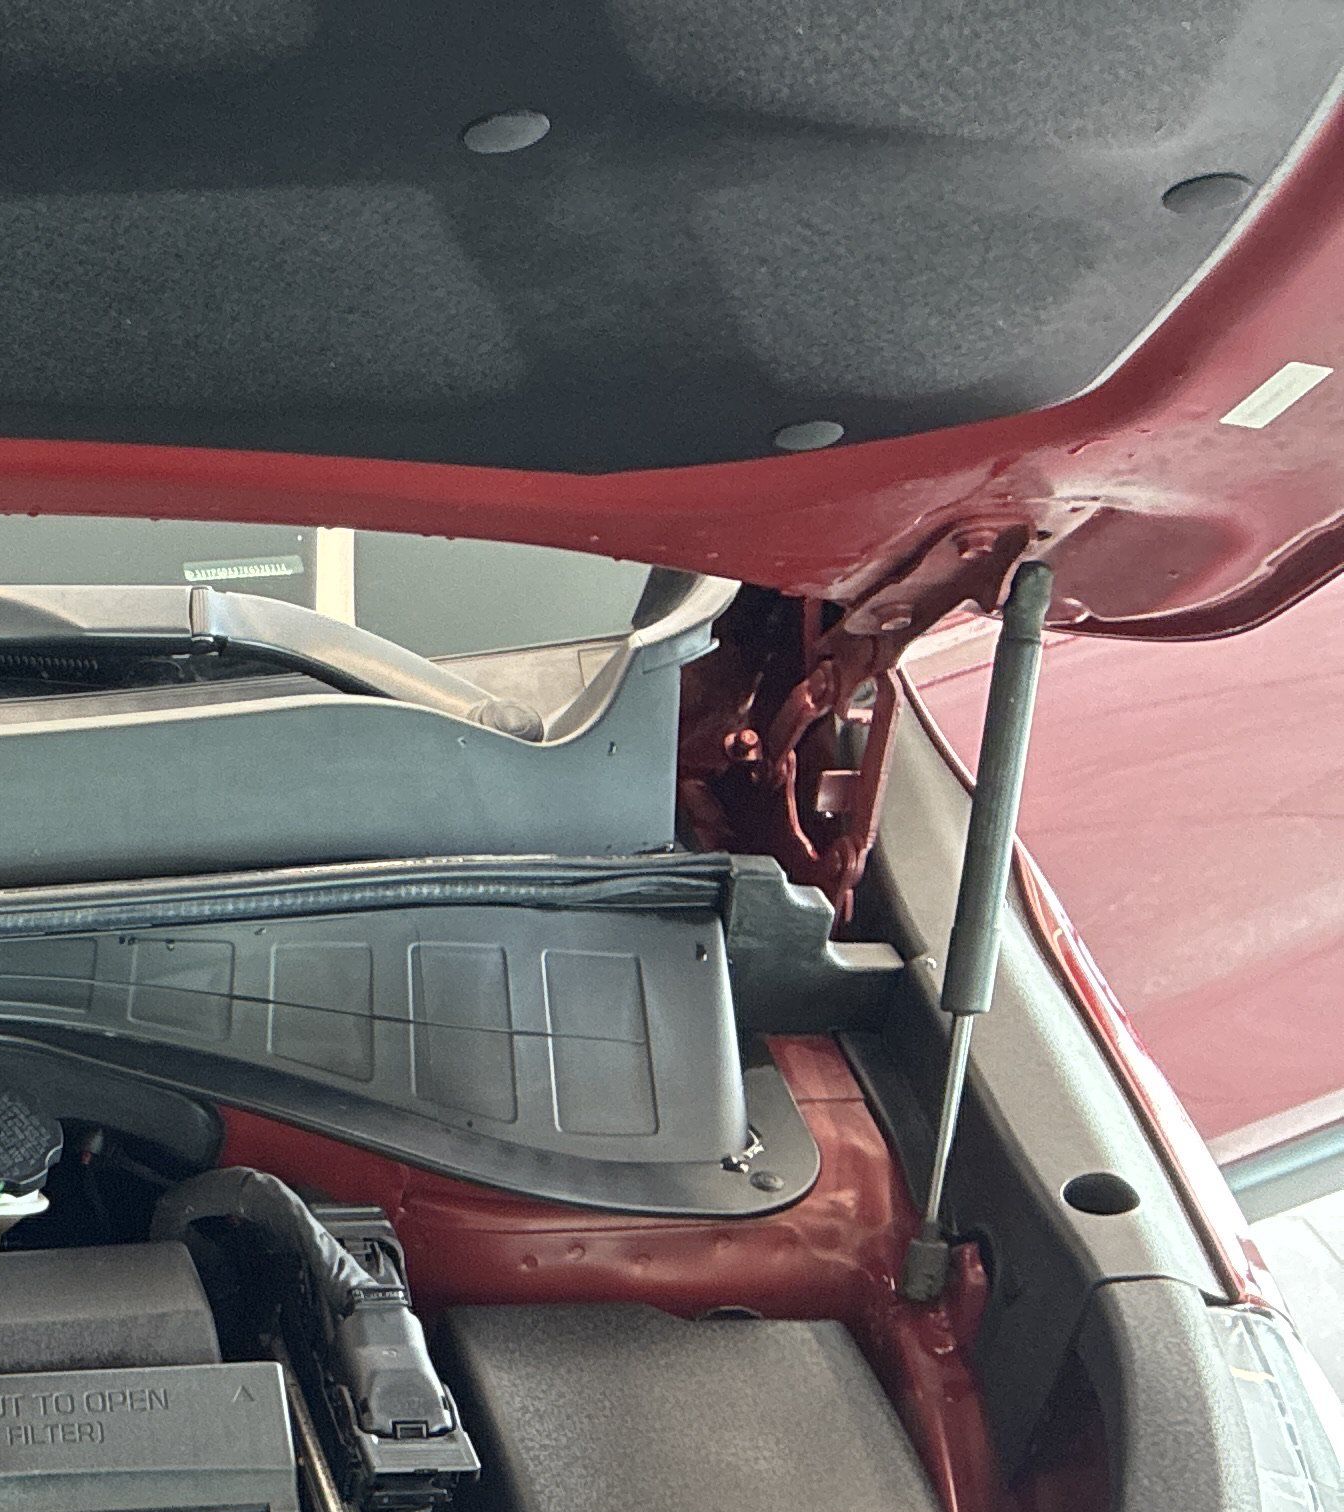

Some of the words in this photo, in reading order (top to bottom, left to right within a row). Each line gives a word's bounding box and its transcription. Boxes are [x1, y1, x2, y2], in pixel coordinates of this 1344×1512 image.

[32, 1391, 75, 1417] TO
[83, 1388, 170, 1414] OPEN
[7, 1420, 105, 1447] FILTER)
